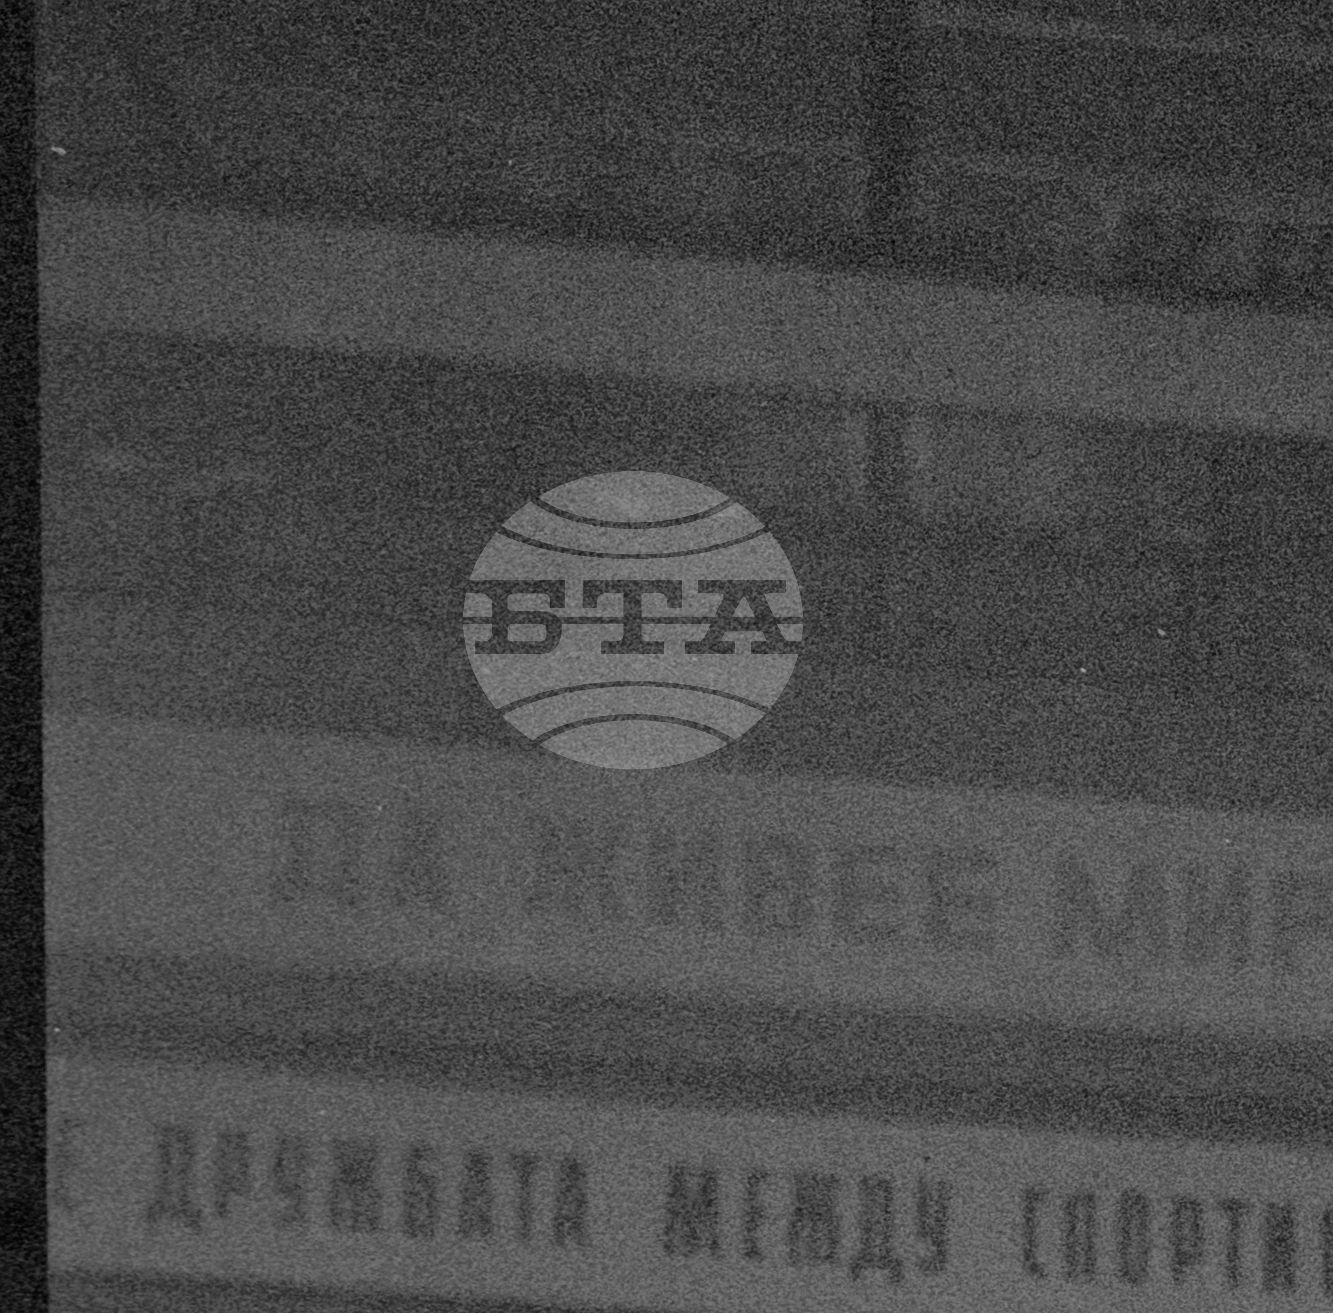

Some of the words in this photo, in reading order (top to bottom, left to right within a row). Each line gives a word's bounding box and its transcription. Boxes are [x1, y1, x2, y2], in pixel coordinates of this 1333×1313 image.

[270, 795, 452, 914] ДА
[522, 808, 1000, 954] ЖИВЕЕ
[147, 1122, 590, 1252] ДРУЖБАТА
[662, 1160, 953, 1286] МЕЖДУ
